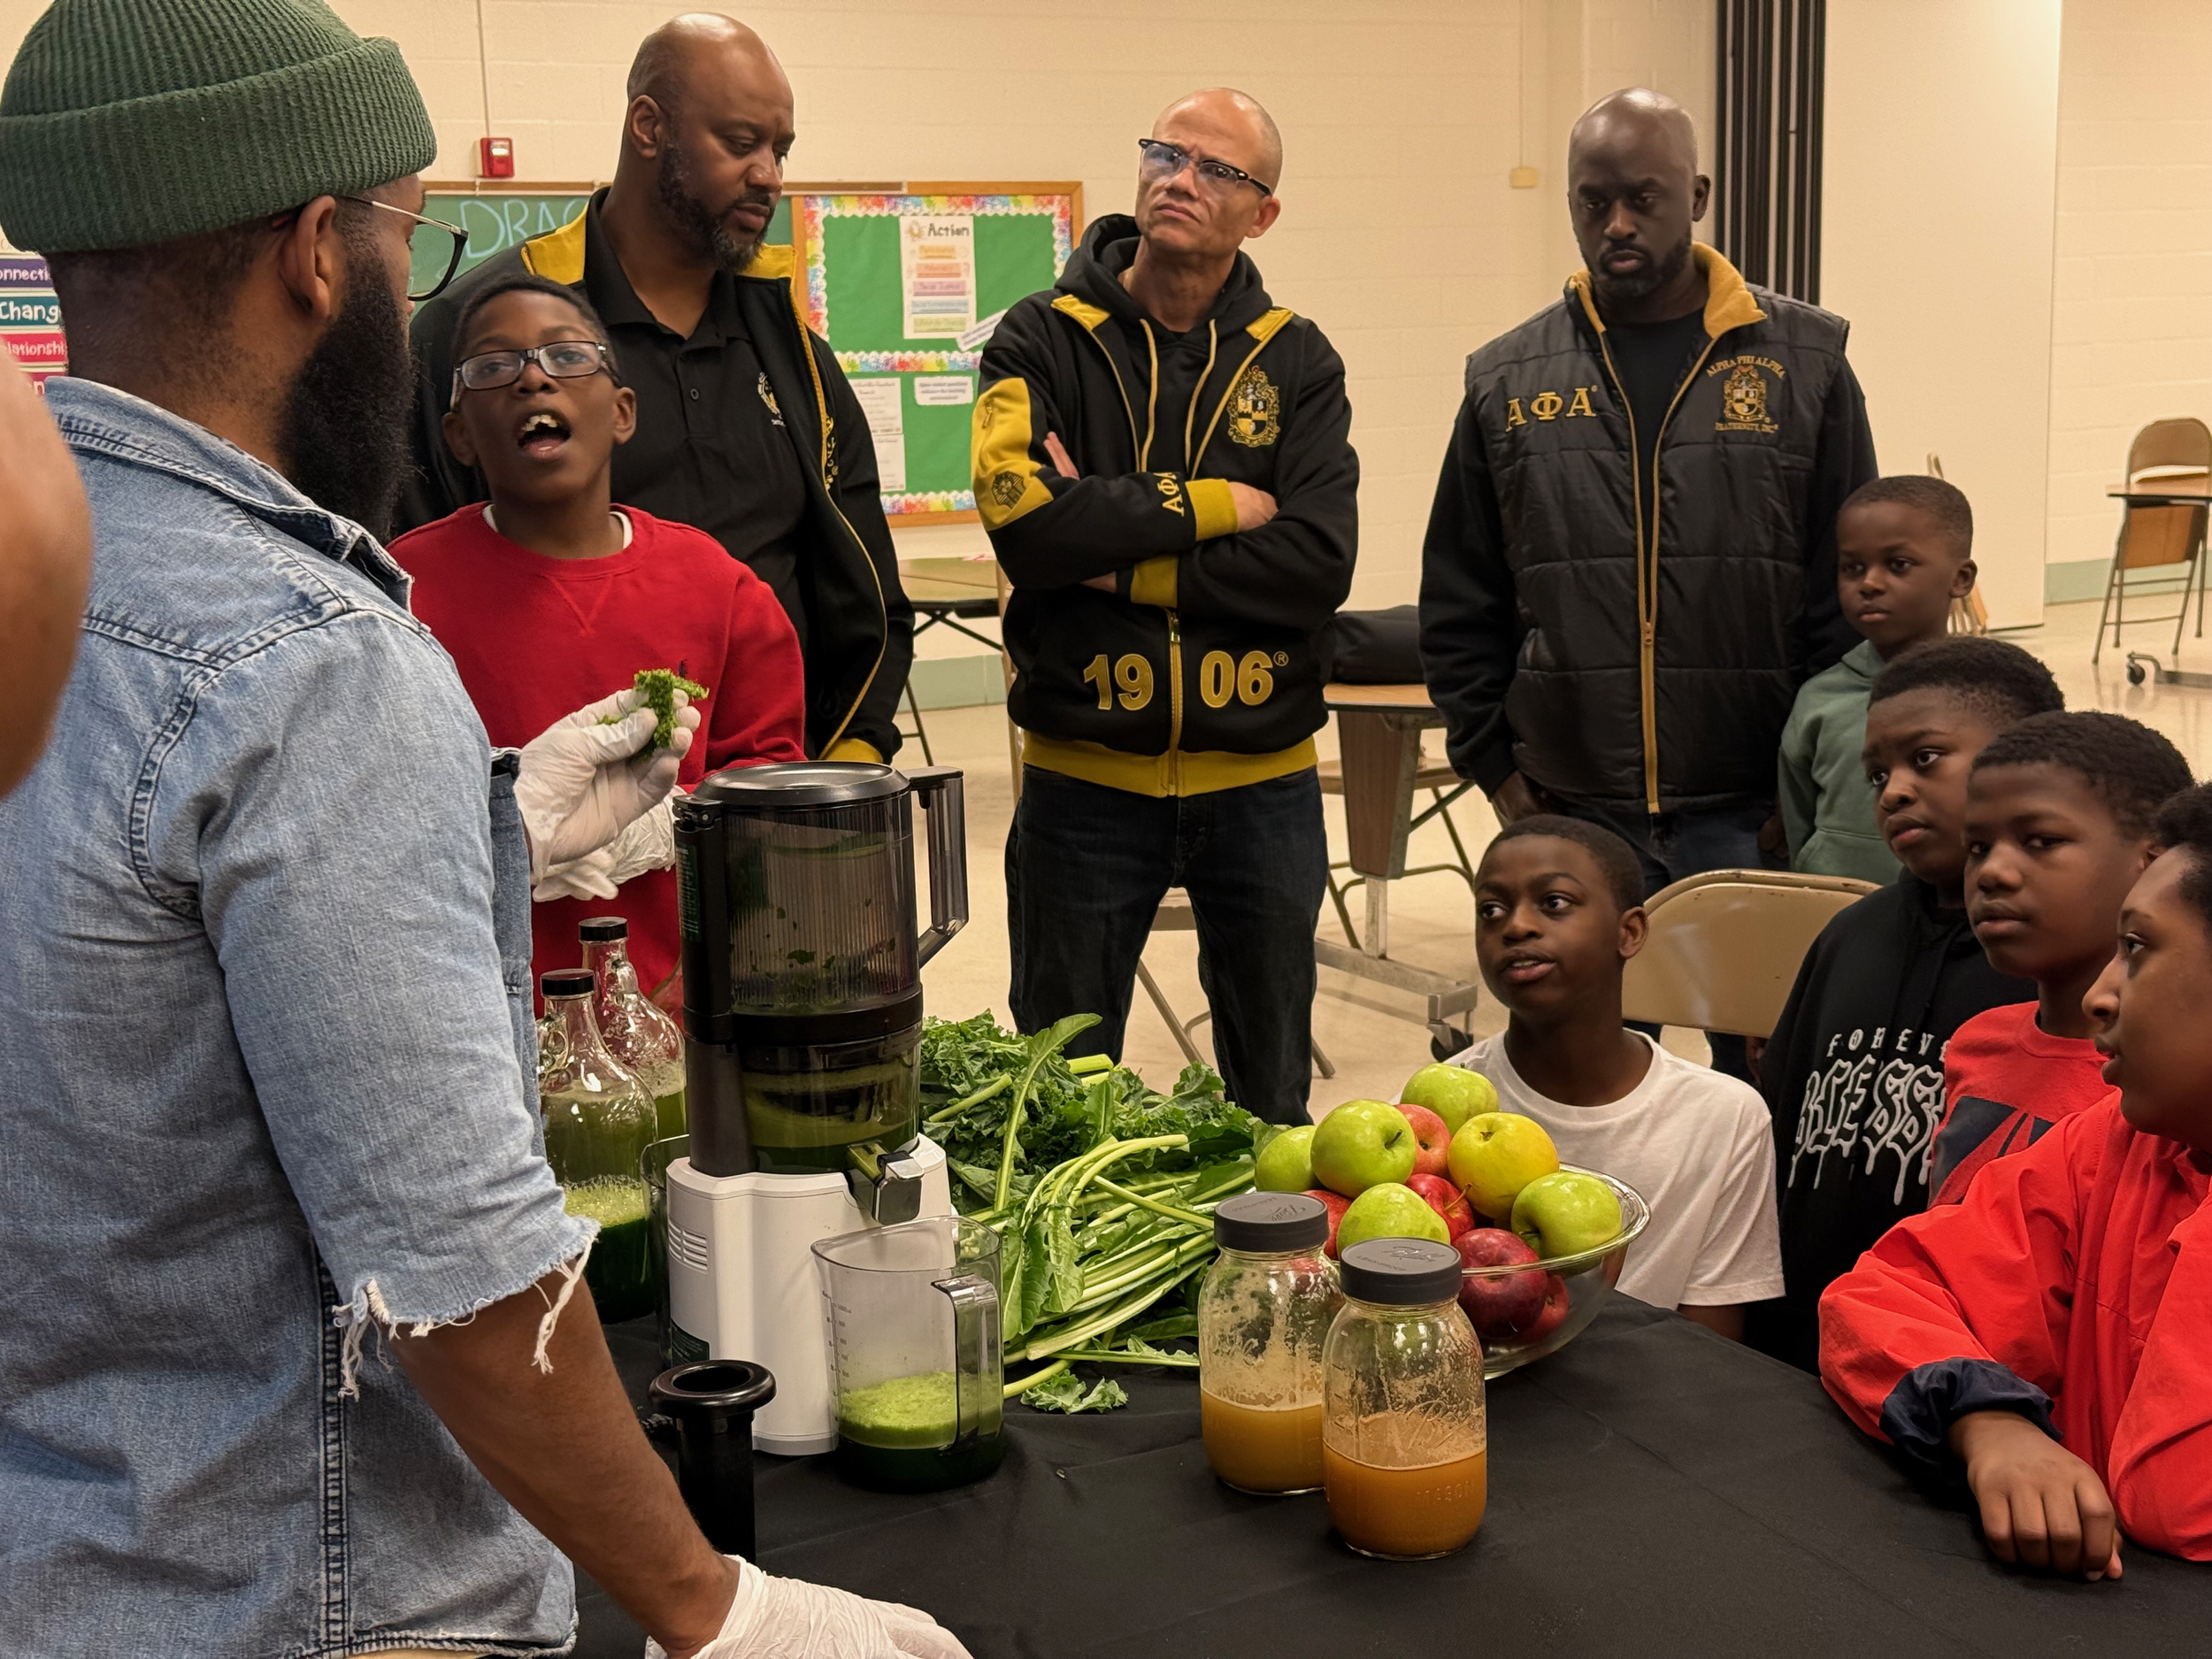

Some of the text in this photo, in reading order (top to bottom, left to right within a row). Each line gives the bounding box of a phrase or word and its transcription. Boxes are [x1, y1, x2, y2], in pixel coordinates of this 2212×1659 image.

[927, 222, 970, 237] Action
[0, 265, 51, 281] nnecti
[0, 301, 61, 324] Chang
[4, 340, 66, 356] lationshi
[1706, 355, 1786, 379] ALPHA PHI ALPHA
[1083, 653, 1154, 711] 19
